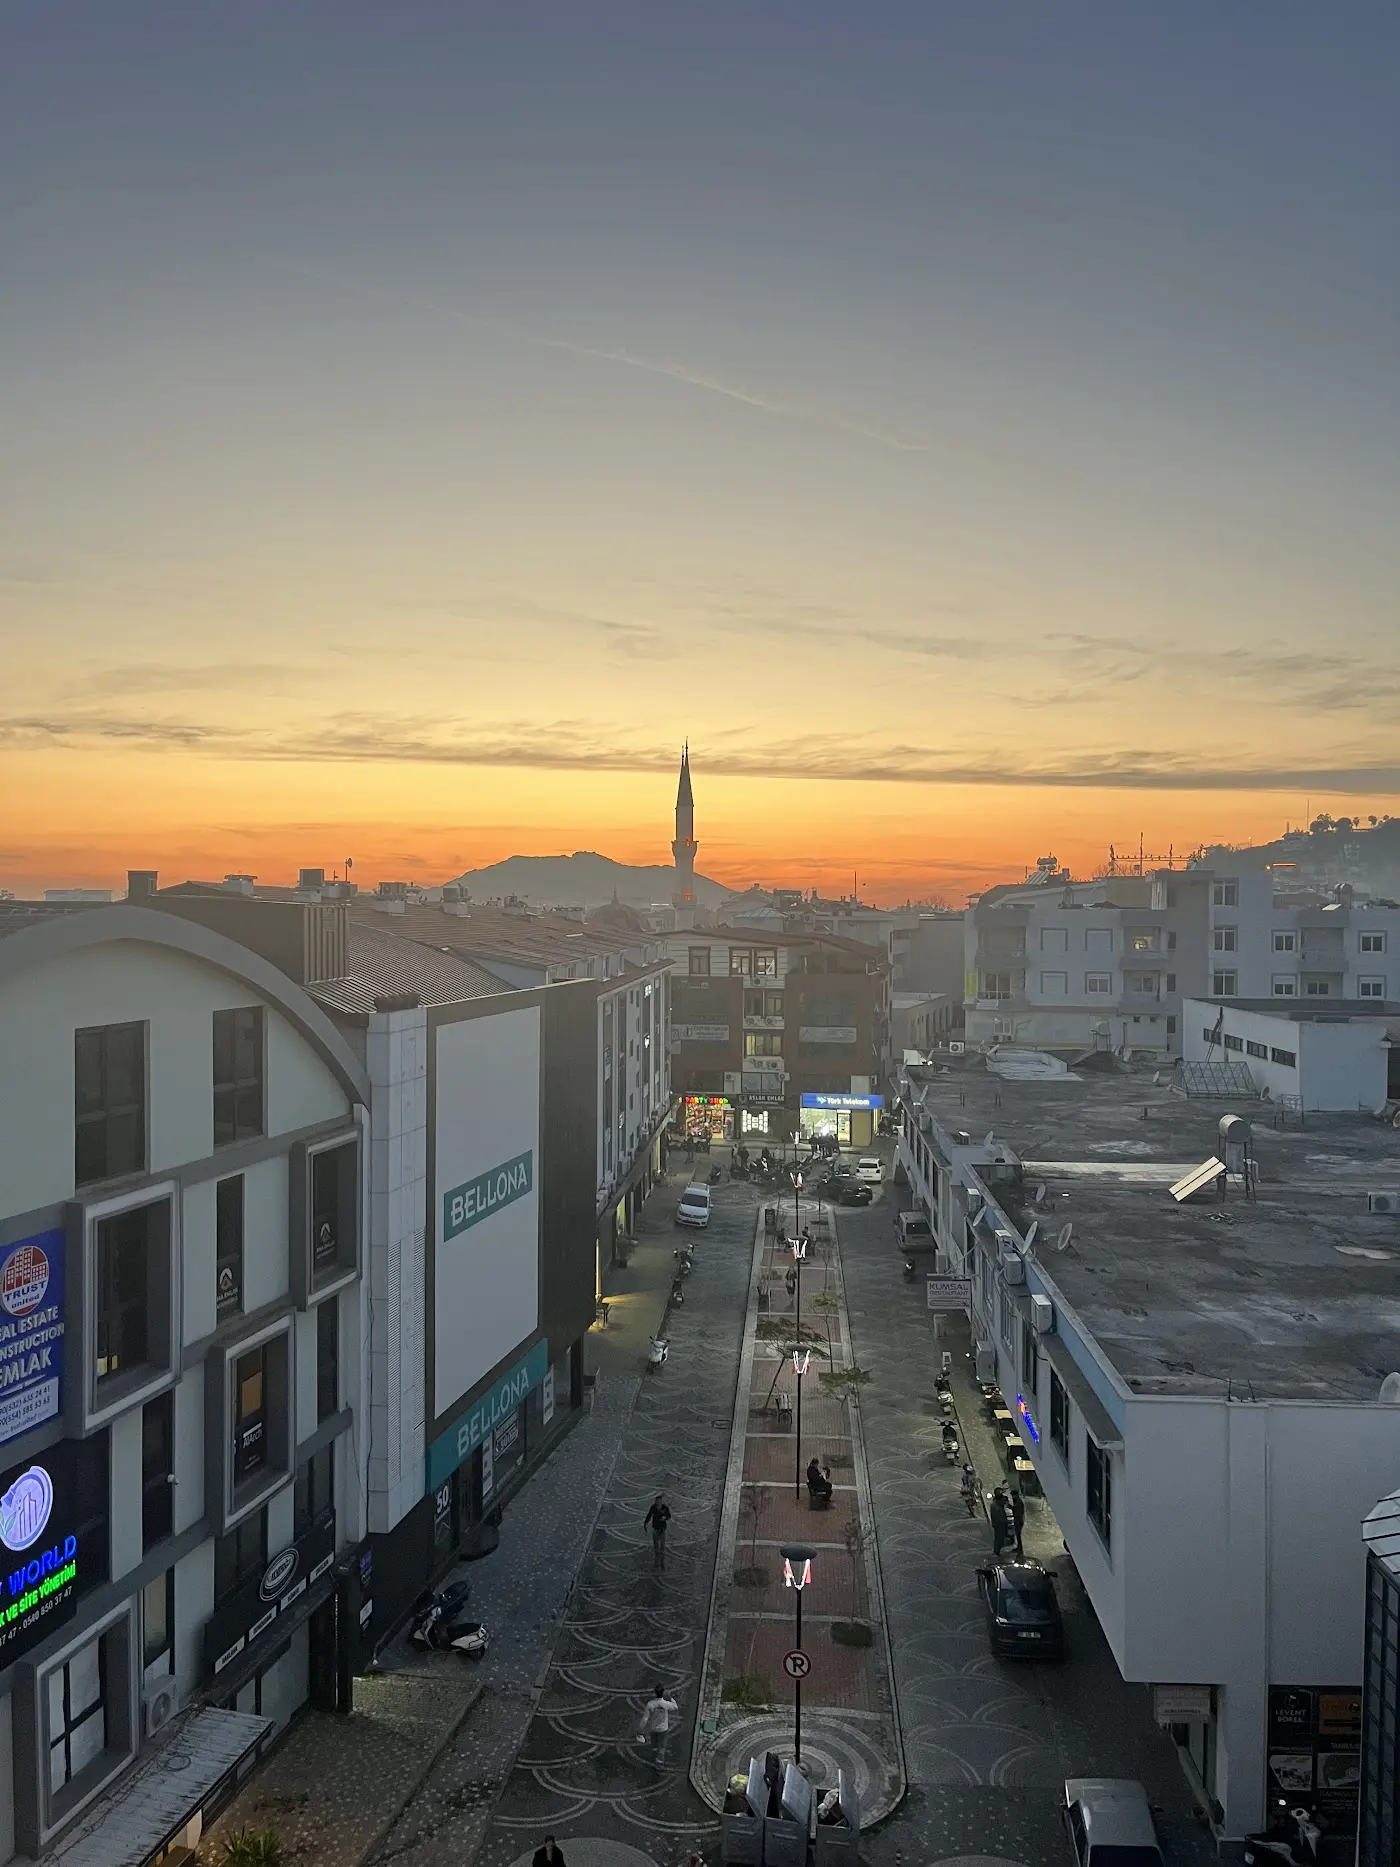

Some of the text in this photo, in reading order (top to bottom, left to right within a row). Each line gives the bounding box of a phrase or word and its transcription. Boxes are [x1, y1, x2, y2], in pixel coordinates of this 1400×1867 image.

[827, 1096, 870, 1107] Türk Telekom
[450, 1162, 528, 1227] BELLONA
[4, 1280, 47, 1302] TRUST
[11, 1293, 40, 1309] united
[929, 1283, 969, 1291] KUMSAL
[19, 1305, 59, 1334] ESTATE
[456, 1366, 530, 1458] BELLONA
[436, 1485, 449, 1514] 50
[8, 1535, 77, 1596] WORLD
[5, 1602, 19, 1622] VE
[19, 1592, 39, 1613] SİTE
[39, 1559, 76, 1599] YÖNETİMİ
[8, 1627, 17, 1640] 47
[22, 1609, 40, 1629] 0540
[40, 1600, 54, 1616] 850
[54, 1592, 63, 1606] 37
[63, 1585, 72, 1597] 47
[1275, 1709, 1307, 1717] LEVENT
